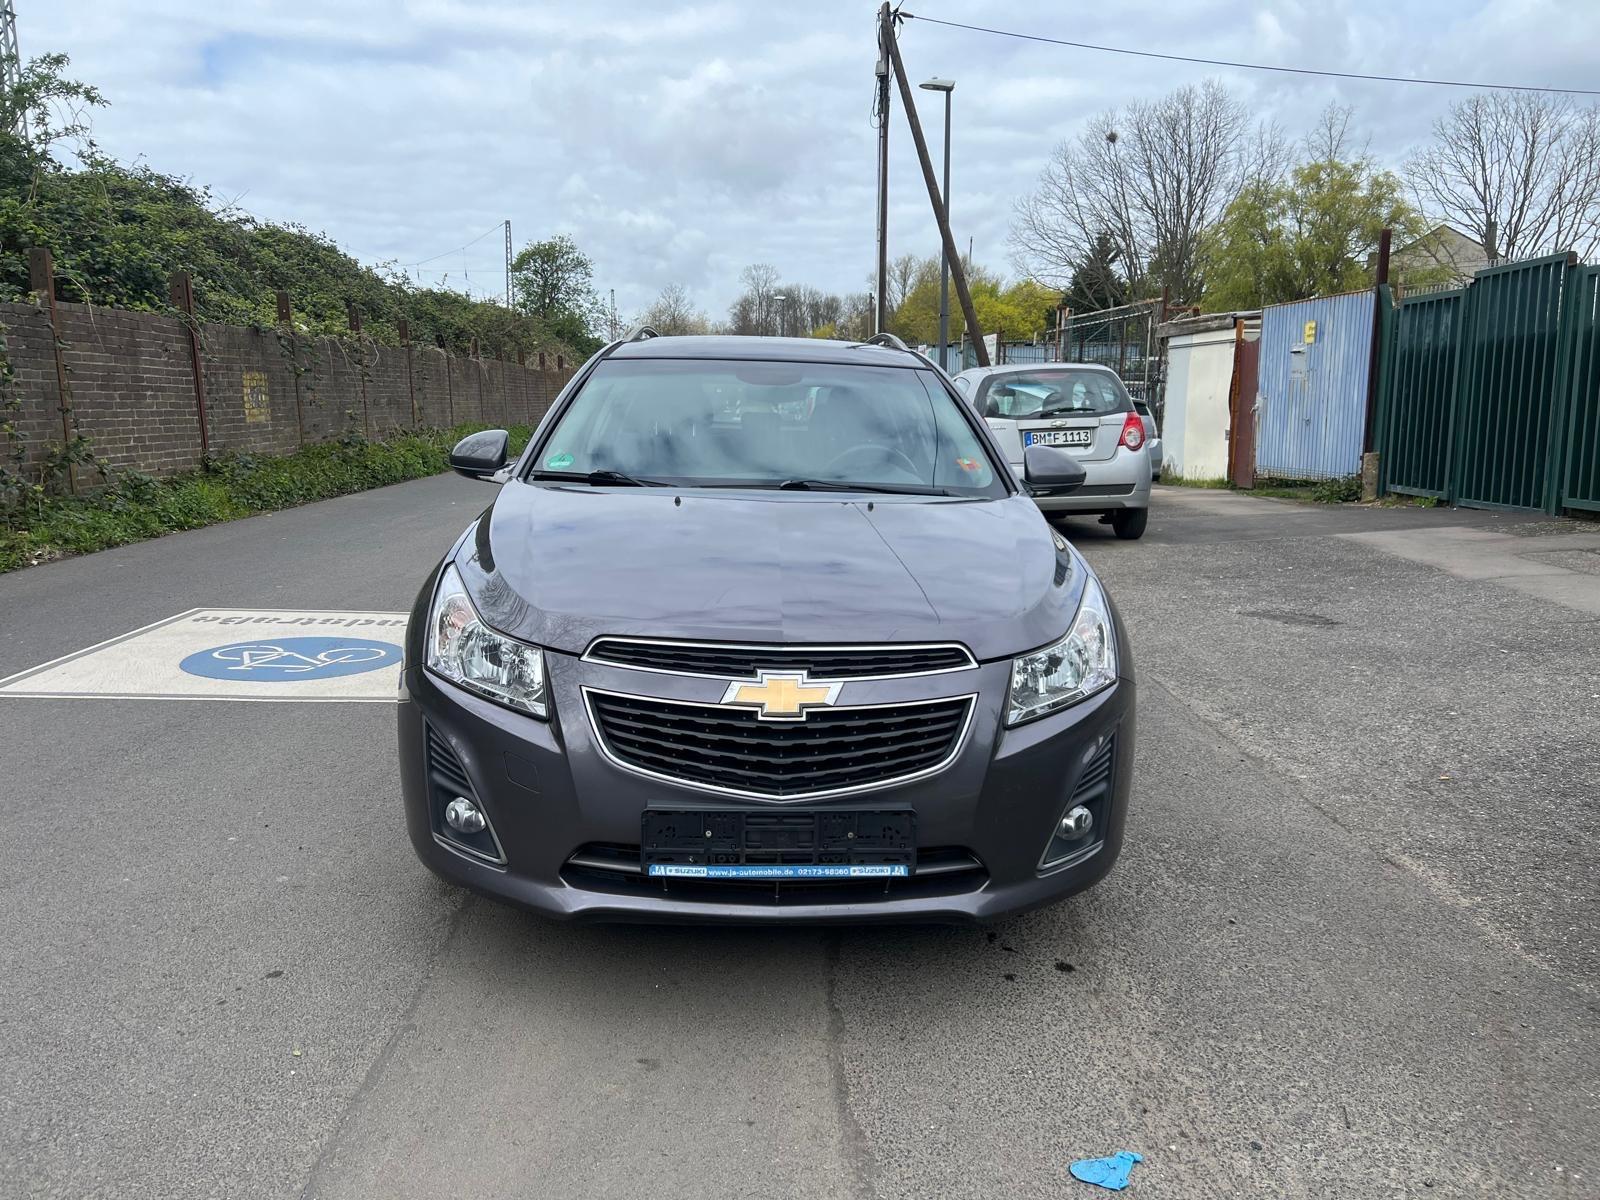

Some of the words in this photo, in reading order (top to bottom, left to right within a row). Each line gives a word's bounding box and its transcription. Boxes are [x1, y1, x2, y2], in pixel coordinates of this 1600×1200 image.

[1032, 431, 1046, 444] BM
[1053, 433, 1060, 443] F
[1063, 431, 1090, 443] 1113
[674, 867, 706, 875] SUZUKI
[708, 867, 793, 876] www.ja-automobile.de
[856, 867, 889, 875] SUZUKI
